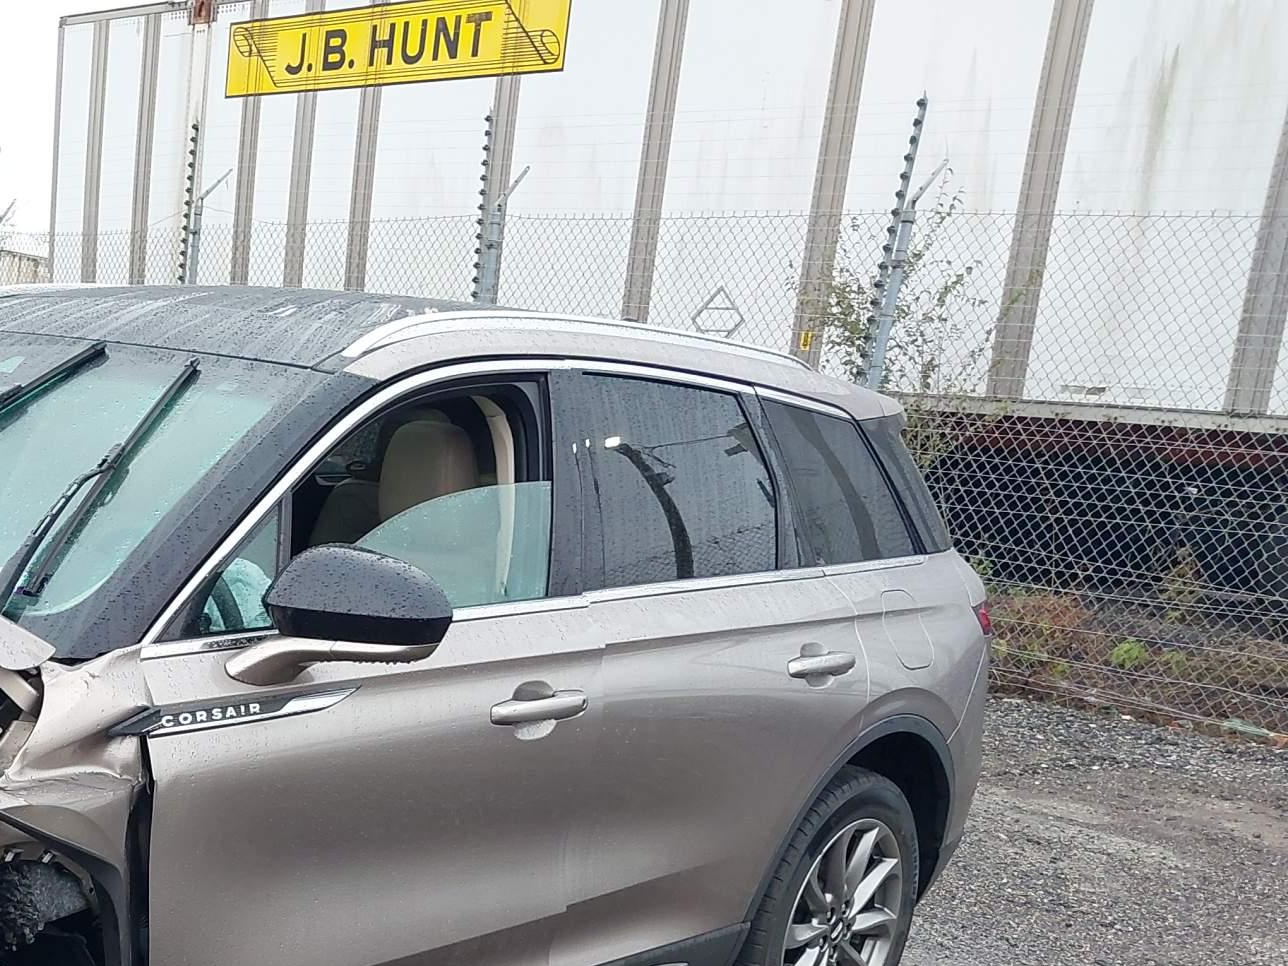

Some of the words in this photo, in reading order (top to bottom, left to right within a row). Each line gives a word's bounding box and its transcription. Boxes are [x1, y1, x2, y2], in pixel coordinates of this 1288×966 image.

[285, 29, 355, 76] J.B.
[368, 11, 493, 68] HUNT
[161, 703, 261, 728] CORSAIR
